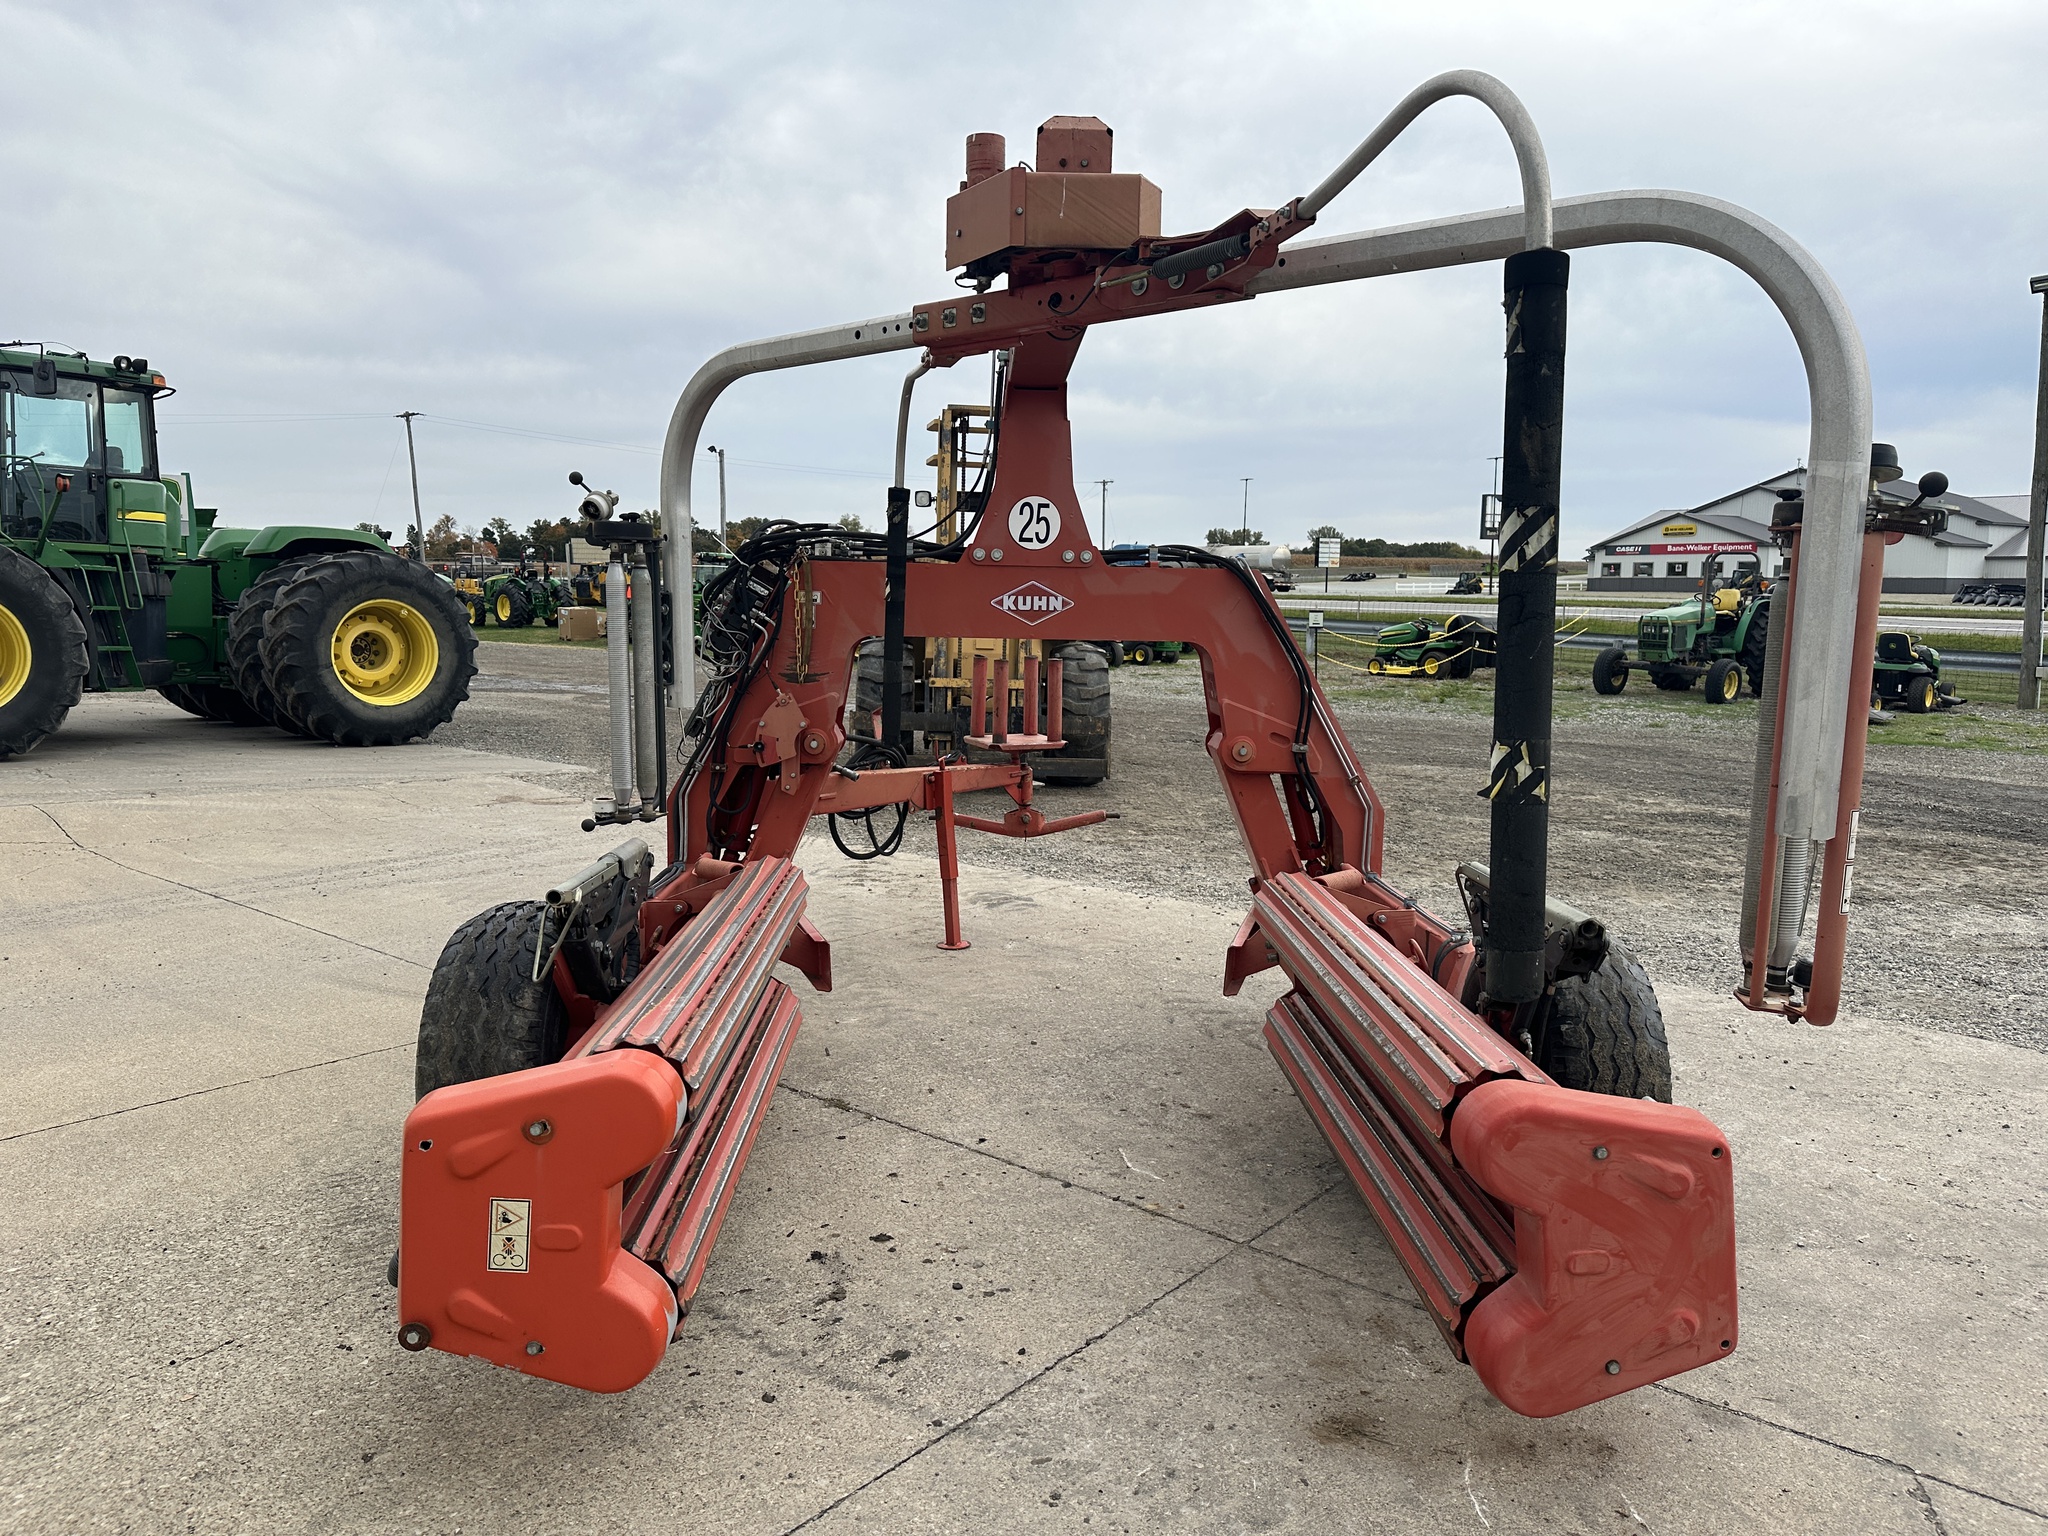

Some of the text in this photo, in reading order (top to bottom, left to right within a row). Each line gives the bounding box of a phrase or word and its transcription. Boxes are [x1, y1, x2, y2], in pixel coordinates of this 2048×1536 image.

[1018, 501, 1051, 544] 25
[1667, 543, 1753, 553] Bane-Welker Equipment
[1002, 595, 1063, 611] KUHN
